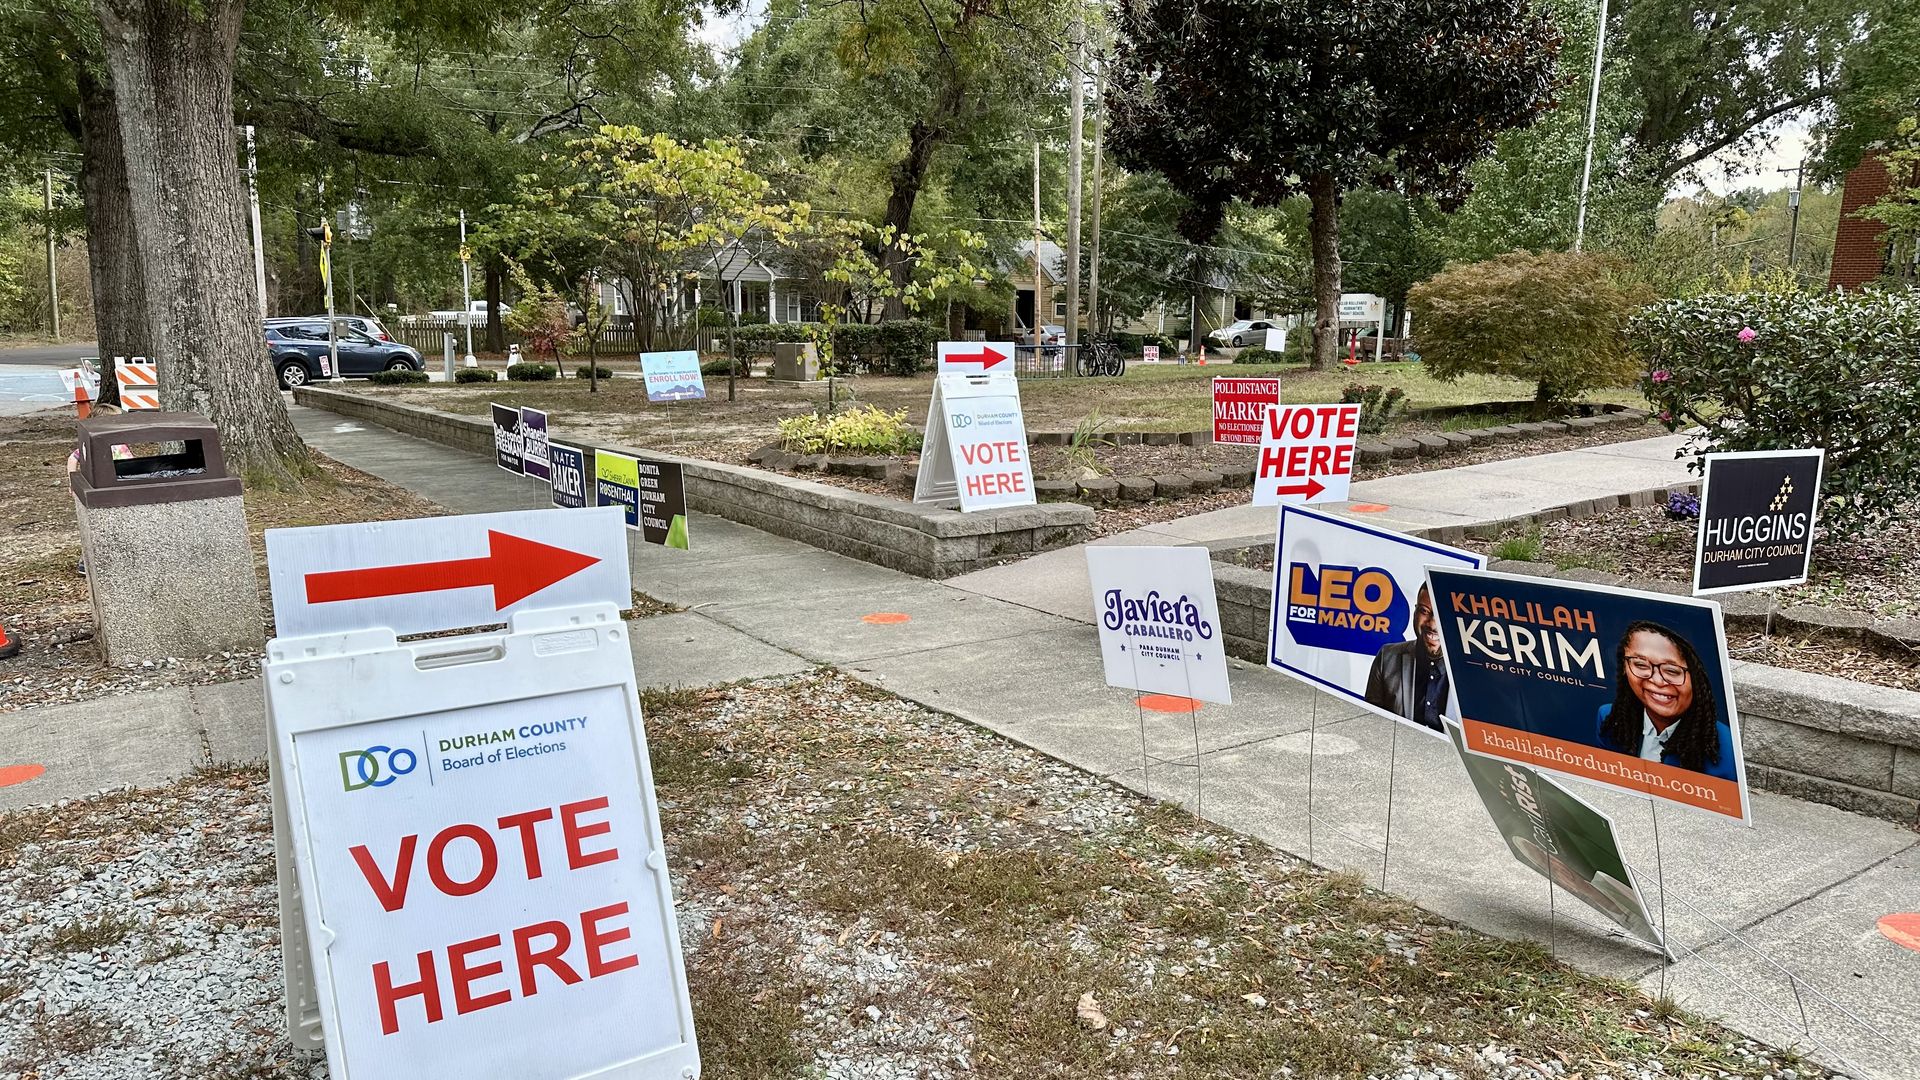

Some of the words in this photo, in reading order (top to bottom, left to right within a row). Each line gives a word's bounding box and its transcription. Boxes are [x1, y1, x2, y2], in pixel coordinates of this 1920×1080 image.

[649, 375, 678, 383] ENROLL
[1215, 383, 1235, 394] POLL
[1237, 383, 1277, 395] DISTANCE
[1215, 401, 1275, 420] MARKE
[1268, 407, 1358, 440] VOTE
[496, 436, 522, 458] FREEMAN
[526, 438, 548, 458] BURRIS
[1221, 434, 1241, 442] BEYOND
[554, 451, 575, 466] NATE
[960, 442, 1020, 465] VOTE
[1260, 444, 1353, 478] HERE
[552, 462, 582, 497] BAKER
[639, 464, 659, 475] BONITA
[600, 482, 635, 503] ROSENTHAL
[640, 478, 658, 488] GREEN
[966, 472, 1025, 496] HERE
[641, 491, 666, 503] DURHAM
[643, 504, 655, 514] CITY
[644, 517, 668, 529] COUNCIL
[1706, 513, 1806, 546] HUGGINS
[1704, 549, 1743, 563] DURHAM
[1745, 547, 1765, 560] CITY
[1766, 544, 1804, 558] COUNCIL
[1290, 566, 1394, 614] LEO
[1104, 589, 1212, 639] Javiera
[1290, 606, 1316, 619] FOR
[1318, 610, 1390, 633] MAYOR
[1451, 592, 1596, 633] KHALILAH
[1125, 624, 1193, 642] CABALLERO
[1456, 617, 1605, 679] KARIM
[1486, 662, 1504, 672] FOR
[1510, 666, 1532, 676] CITY
[1537, 671, 1584, 686] COUNCIL
[439, 728, 515, 752] DURHAM
[519, 716, 587, 739] COUNTY
[442, 752, 484, 771] Board
[488, 749, 502, 763] of
[506, 740, 566, 760] Elections
[1482, 729, 1717, 801] khalilahfordurham.com
[1504, 763, 1542, 818] Rist
[348, 796, 619, 913] VOTE
[372, 901, 639, 1036] HERE
